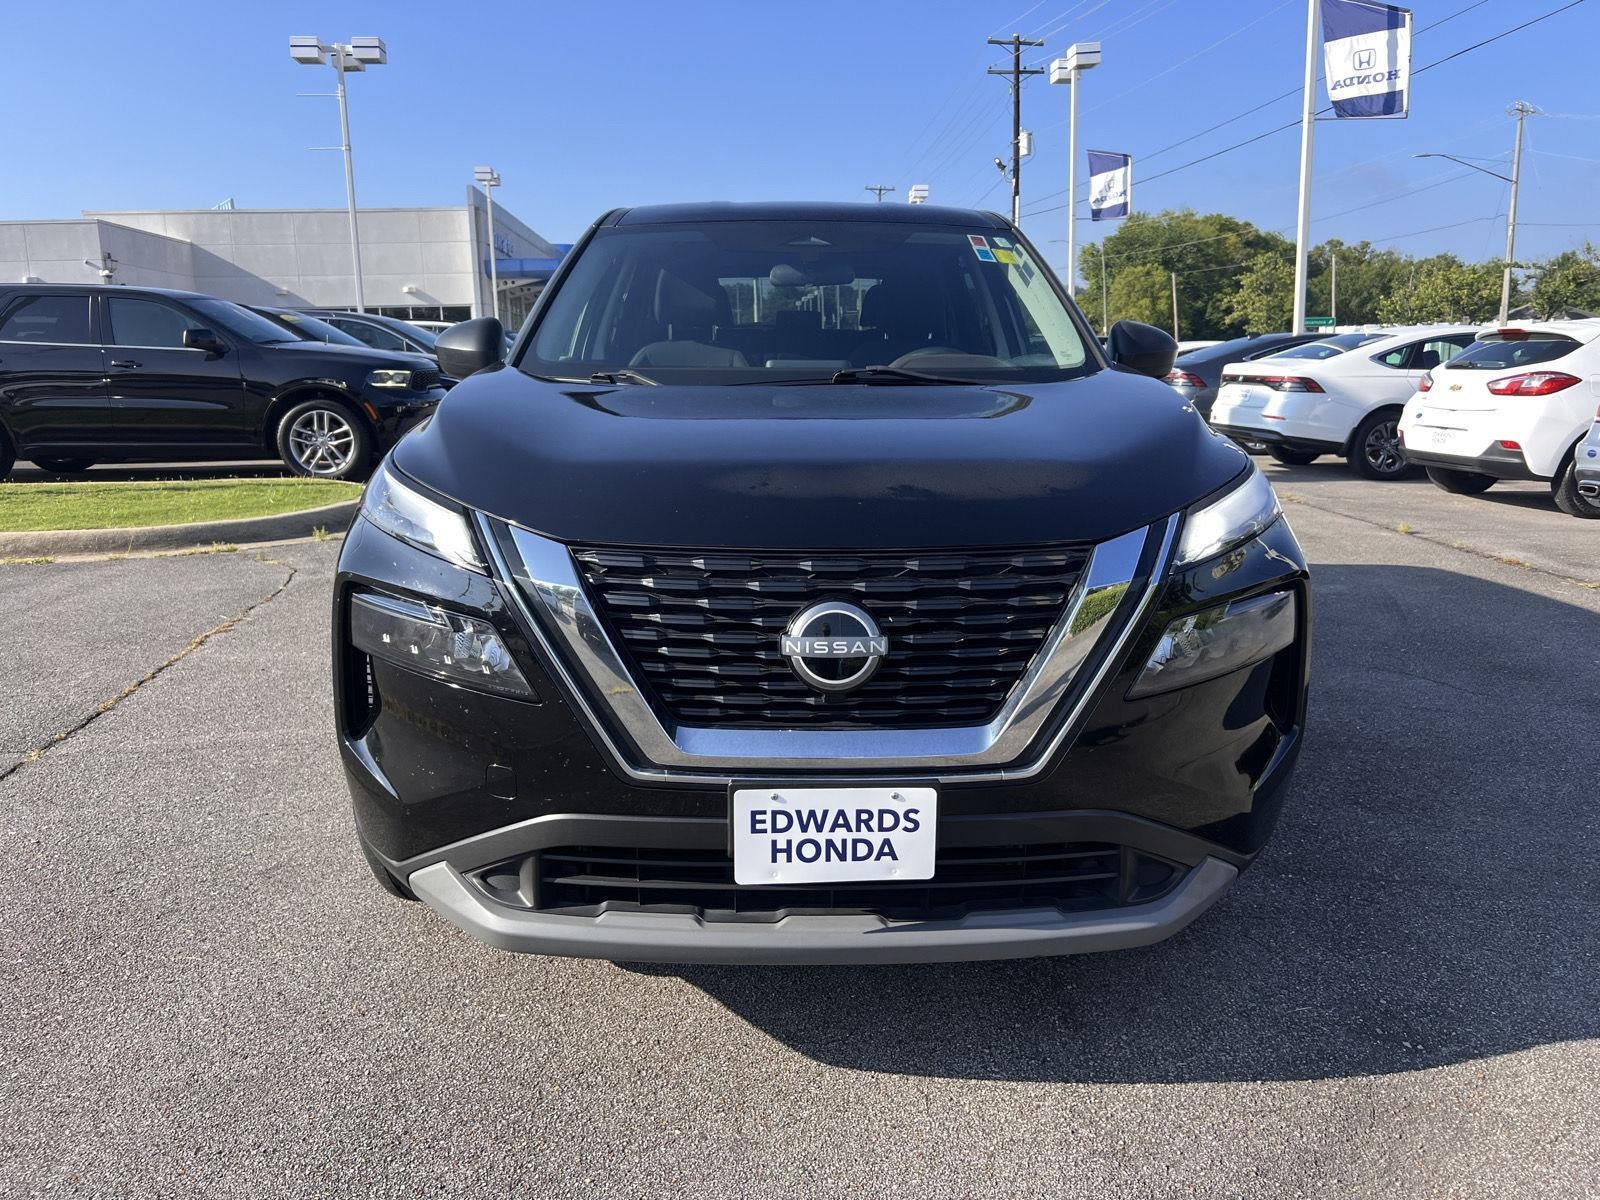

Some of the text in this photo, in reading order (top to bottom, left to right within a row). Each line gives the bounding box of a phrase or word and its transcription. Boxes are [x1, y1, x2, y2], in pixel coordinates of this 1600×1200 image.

[786, 641, 885, 654] NISSAN
[750, 808, 920, 834] EDWARDS
[771, 838, 899, 863] HONDA
